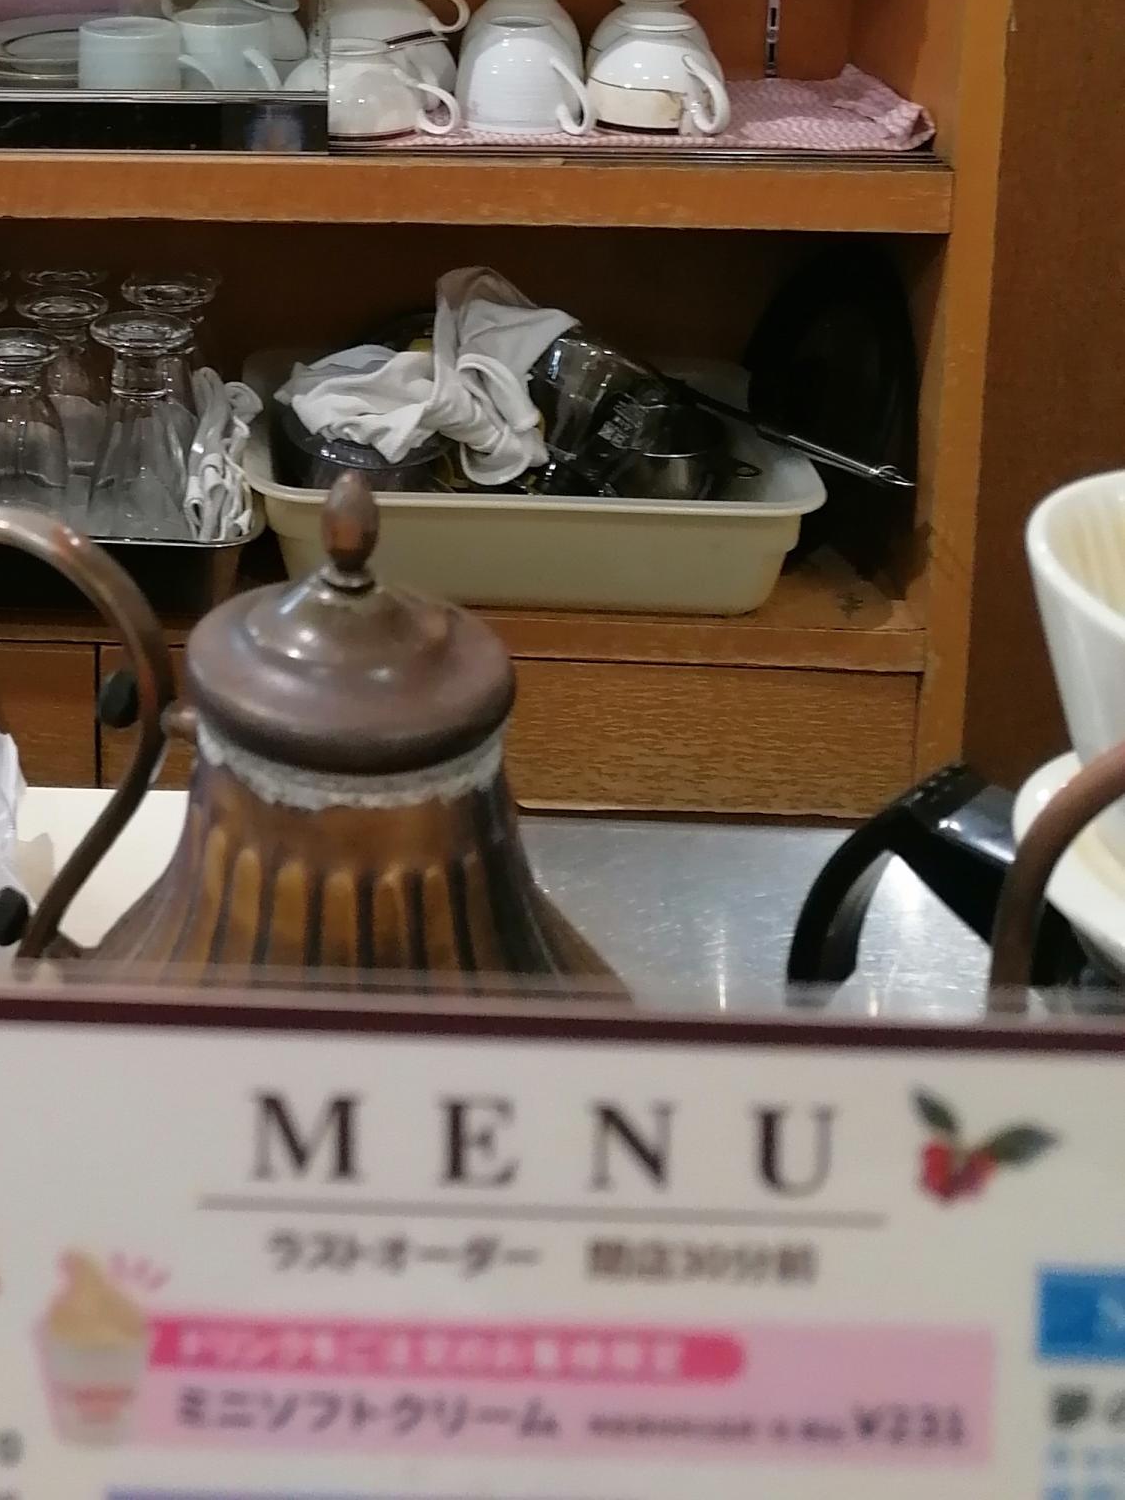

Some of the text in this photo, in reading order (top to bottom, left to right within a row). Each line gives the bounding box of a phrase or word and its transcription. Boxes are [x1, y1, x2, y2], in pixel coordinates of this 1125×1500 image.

[248, 1088, 838, 1200] MENU
[178, 1386, 562, 1440] ミニソフトクリーム
